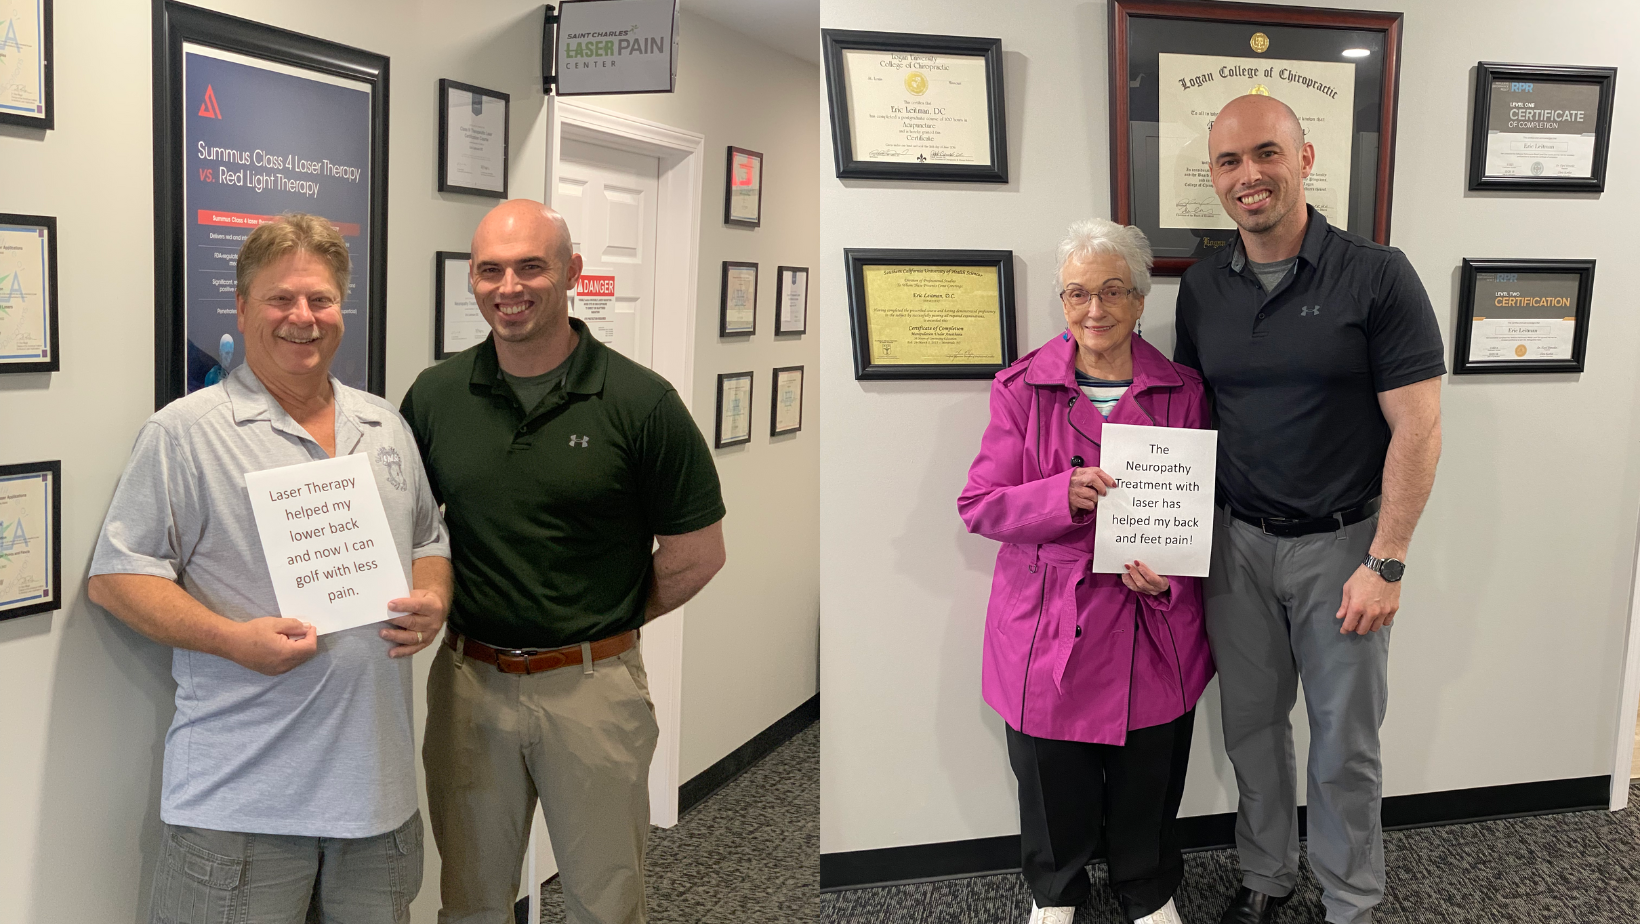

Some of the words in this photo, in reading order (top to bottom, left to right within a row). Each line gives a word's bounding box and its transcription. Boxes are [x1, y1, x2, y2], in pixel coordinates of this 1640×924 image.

[592, 30, 628, 38] CHARLES
[564, 40, 614, 58] LASER
[618, 36, 664, 56] PAIN
[891, 53, 908, 62] Logan
[566, 60, 616, 70] CENTER
[880, 60, 903, 70] College
[914, 62, 950, 71] Chiropractic
[1178, 72, 1214, 91] Logan
[1219, 65, 1258, 78] College
[1264, 66, 1274, 78] of
[1279, 68, 1338, 99] Chiropractic
[1511, 82, 1533, 92] RPR
[1510, 109, 1584, 121] CERTIFICATE
[198, 141, 250, 165] Summus
[254, 150, 283, 169] Class
[286, 155, 292, 170] 4
[295, 155, 321, 174] Laser
[323, 160, 361, 183] Therapy
[200, 168, 215, 182] vs.
[219, 167, 243, 186] Red
[247, 170, 274, 192] Light
[276, 174, 319, 198] Therapy
[1497, 273, 1517, 282] RPR
[584, 280, 614, 293] DANGER
[1495, 297, 1570, 306] CERTIFICATION
[1149, 444, 1170, 454] The
[1126, 461, 1191, 475] Neuropathy
[269, 487, 302, 502] Laser
[304, 476, 356, 495] Therapy
[1115, 478, 1172, 491] Treatment
[1175, 482, 1200, 492] with
[1132, 497, 1159, 508] laser
[1162, 498, 1181, 509] has
[285, 502, 329, 521] helped
[332, 500, 351, 511] my
[1112, 514, 1150, 527] helped
[1154, 518, 1170, 528] my
[1174, 517, 1199, 527] back
[289, 526, 326, 543] lower
[329, 518, 359, 535] back
[1115, 533, 1136, 544] and
[1140, 534, 1162, 544] feet
[1165, 535, 1193, 546] pain!
[286, 550, 311, 565] and
[314, 545, 341, 561] now
[344, 542, 349, 553] I
[352, 538, 374, 551] can
[295, 570, 320, 589] golf
[322, 564, 351, 580] with
[353, 559, 378, 573] less
[327, 586, 359, 604] pain.
